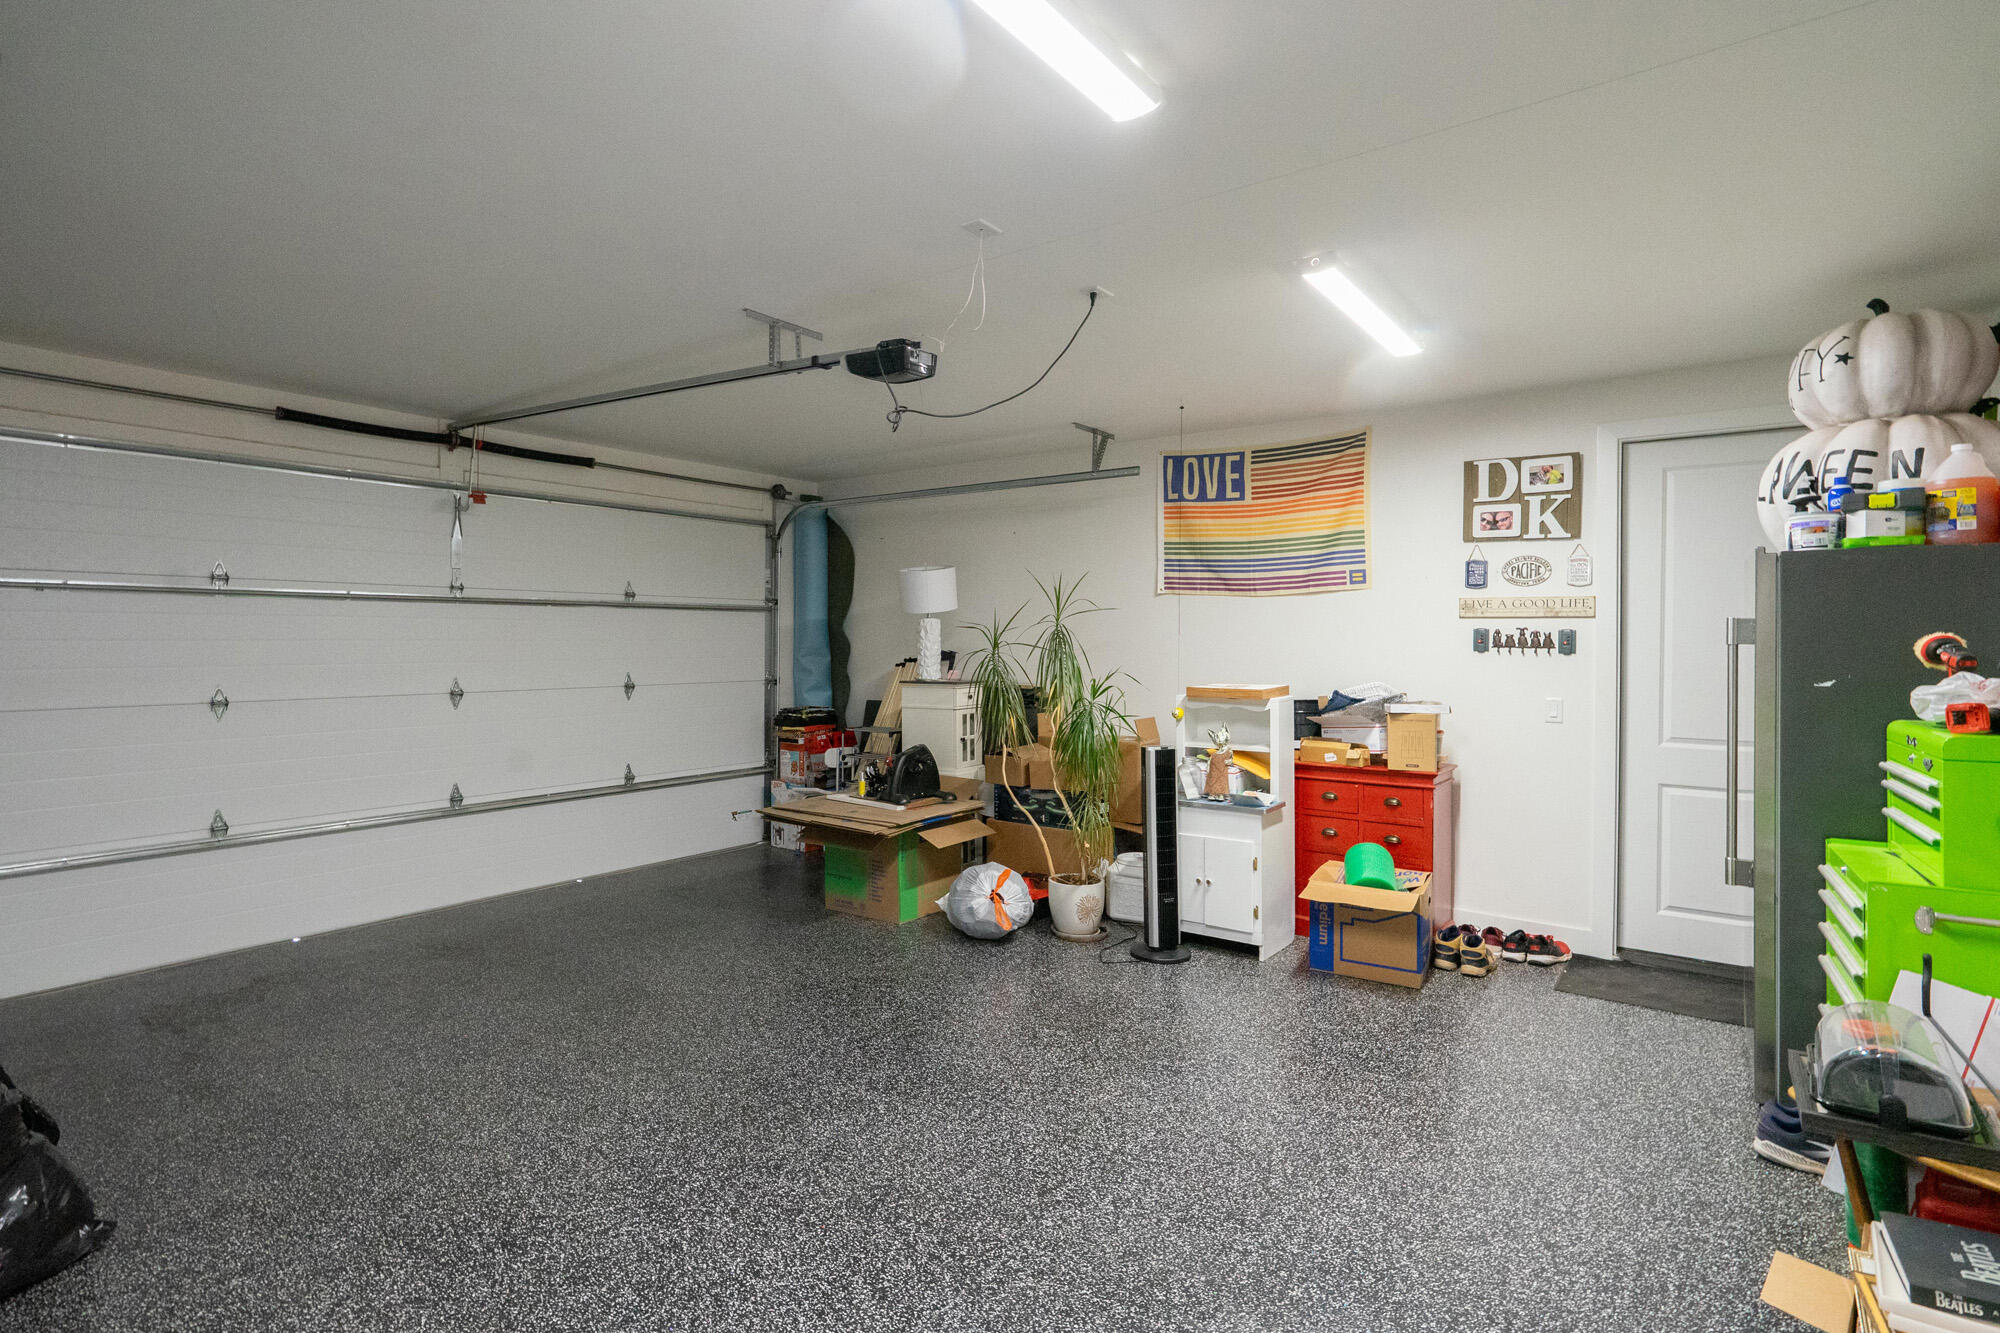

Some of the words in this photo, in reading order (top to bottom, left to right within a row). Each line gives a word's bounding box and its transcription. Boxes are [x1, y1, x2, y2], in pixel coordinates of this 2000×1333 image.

[1166, 454, 1241, 500] LOVE
[1473, 459, 1519, 503] D
[1523, 494, 1571, 539] K
[1510, 561, 1543, 580] PACIFIC
[1464, 599, 1493, 609] LIVE
[1498, 599, 1507, 609] A
[1512, 599, 1556, 609] GOOD
[1560, 598, 1590, 609] LIFE
[1318, 903, 1332, 945] edium
[1935, 1290, 1984, 1317] BEATLES
